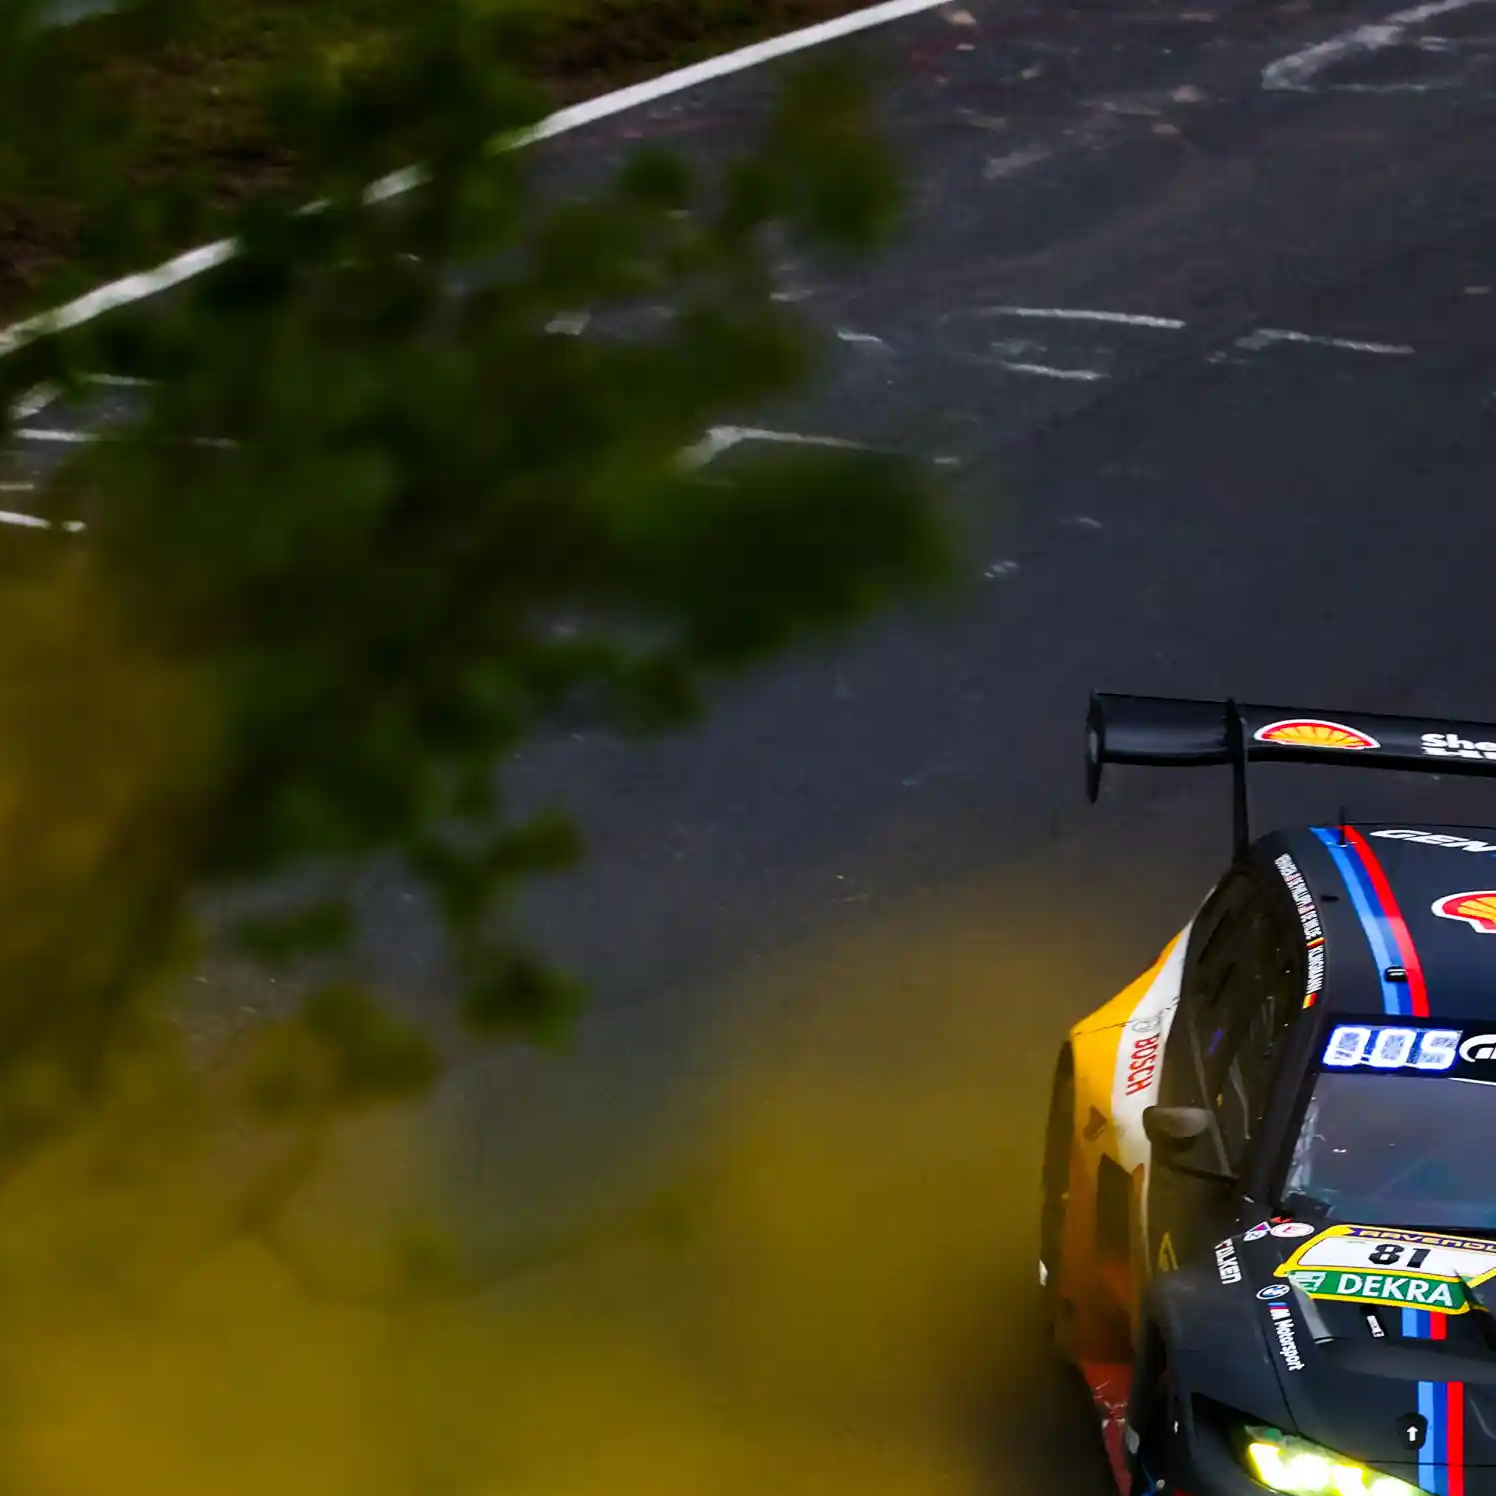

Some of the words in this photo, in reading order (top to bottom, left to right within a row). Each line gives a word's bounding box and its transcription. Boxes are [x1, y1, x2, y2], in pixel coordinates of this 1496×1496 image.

[1125, 1032, 1161, 1096] BOSCH
[1214, 1238, 1242, 1285] FALKEN
[1368, 1243, 1432, 1269] 81
[1337, 1273, 1454, 1307] DEKRA
[1273, 1318, 1305, 1371] Motorsport
